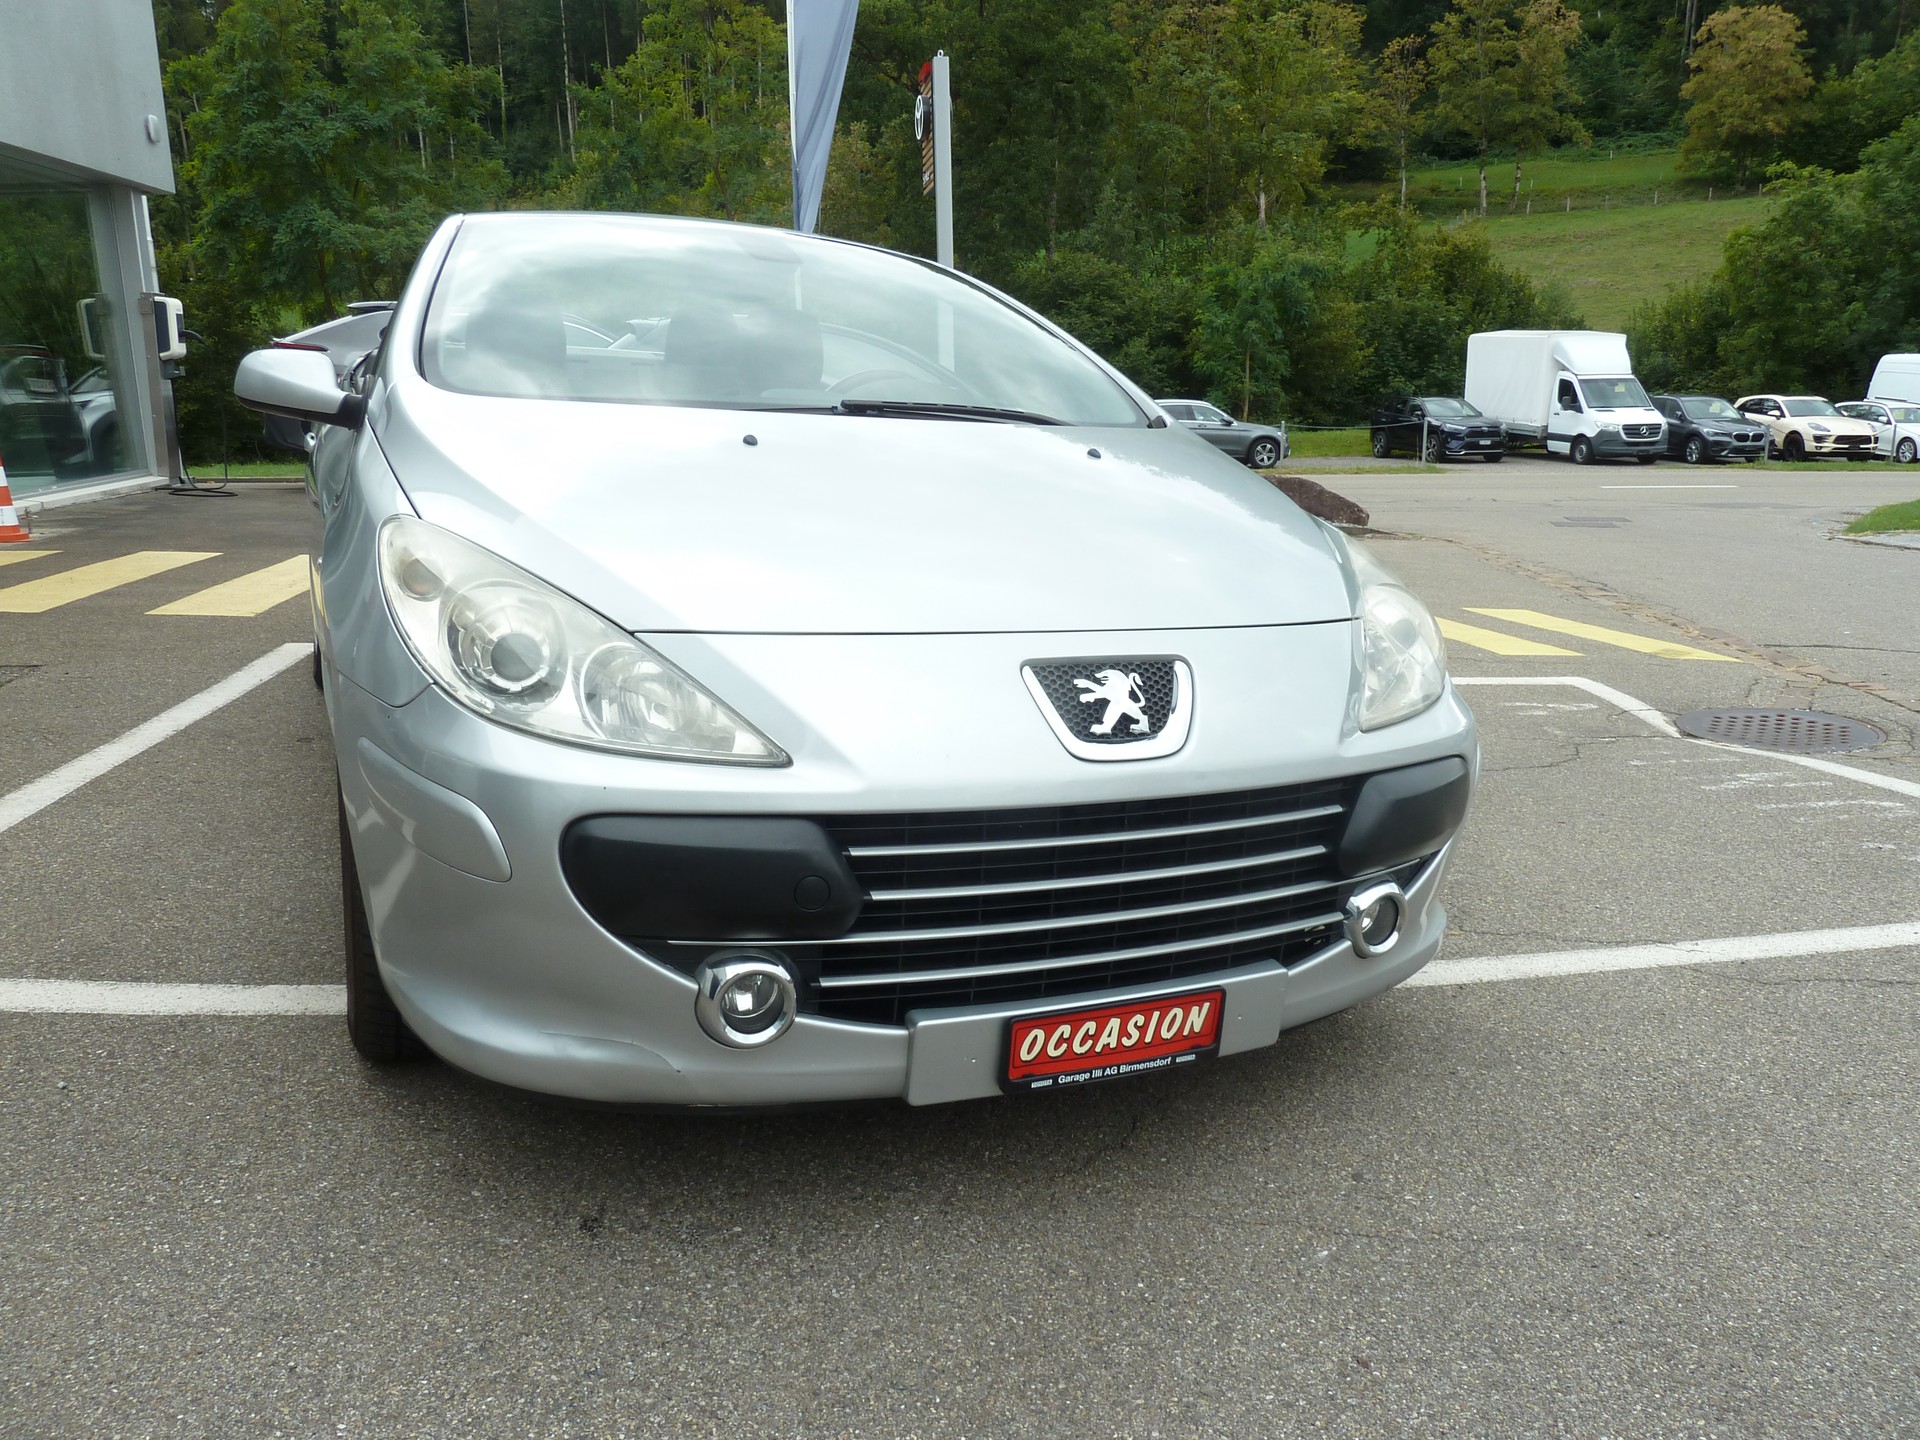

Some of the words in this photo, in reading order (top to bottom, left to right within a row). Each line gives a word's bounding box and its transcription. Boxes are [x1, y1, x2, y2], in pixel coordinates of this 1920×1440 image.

[1020, 1002, 1211, 1062] OCCASION
[1058, 1071, 1090, 1084] Garage
[1104, 1066, 1118, 1076] AG
[1119, 1056, 1172, 1073] Birmensdorf
